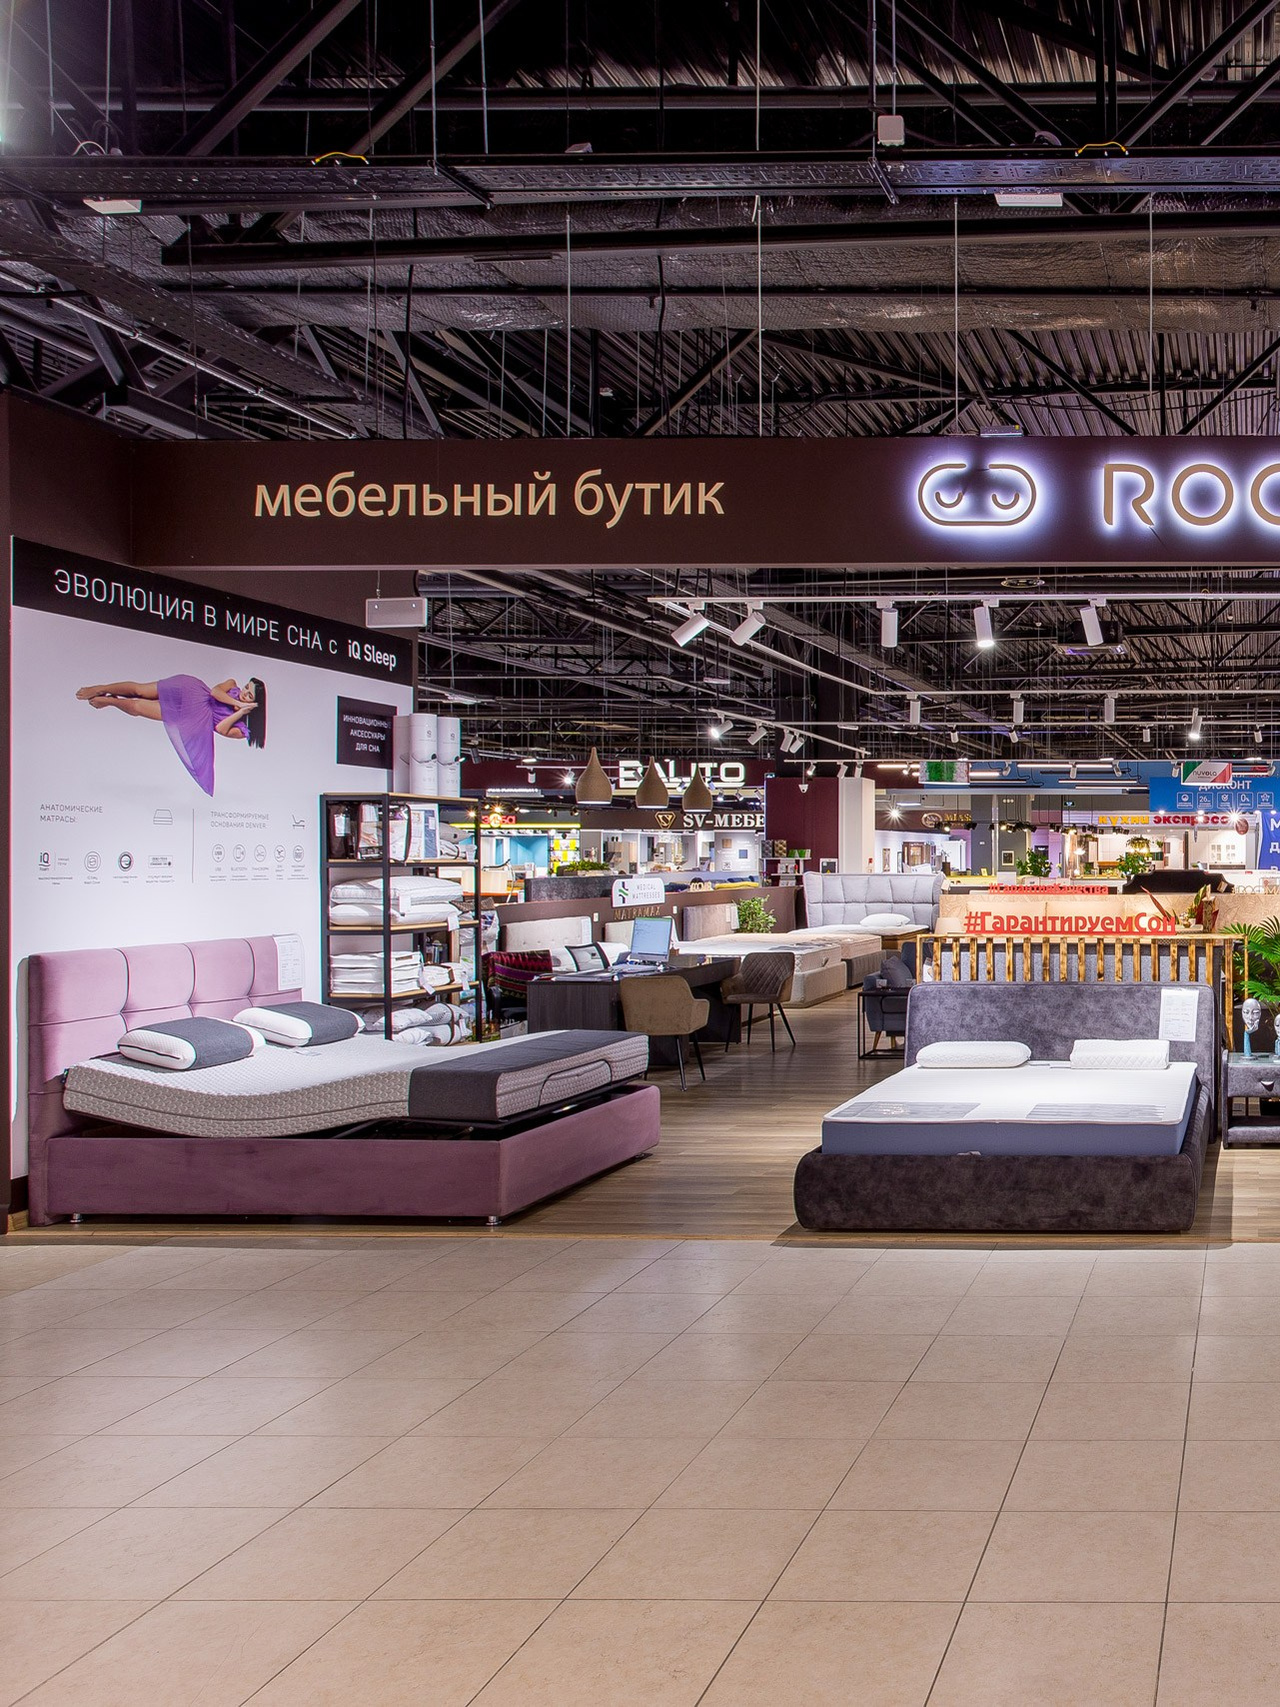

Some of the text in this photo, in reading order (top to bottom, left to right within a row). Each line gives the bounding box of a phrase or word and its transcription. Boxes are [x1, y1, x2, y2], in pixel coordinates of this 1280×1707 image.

[254, 468, 725, 530] мебельный бутик
[53, 568, 195, 623] ЭВОЛЮЦИЯ
[204, 604, 218, 628] В
[226, 609, 280, 643] МИРЕ
[287, 624, 323, 651] СНА
[347, 639, 362, 662] iQ
[363, 643, 397, 672] Sleep
[350, 728, 386, 741] АКСЕССУАРЫ
[355, 742, 381, 753] ДЛЯ СНА
[40, 803, 103, 813] АНАТОМИЧЕСКИЕ
[210, 811, 269, 821] ТРАНСФОРМИРУЕМЫЕ
[1098, 815, 1150, 827] кухни
[210, 820, 244, 829] ОСНОВАНИЯ
[964, 911, 1177, 935] #ГарантируемСон
